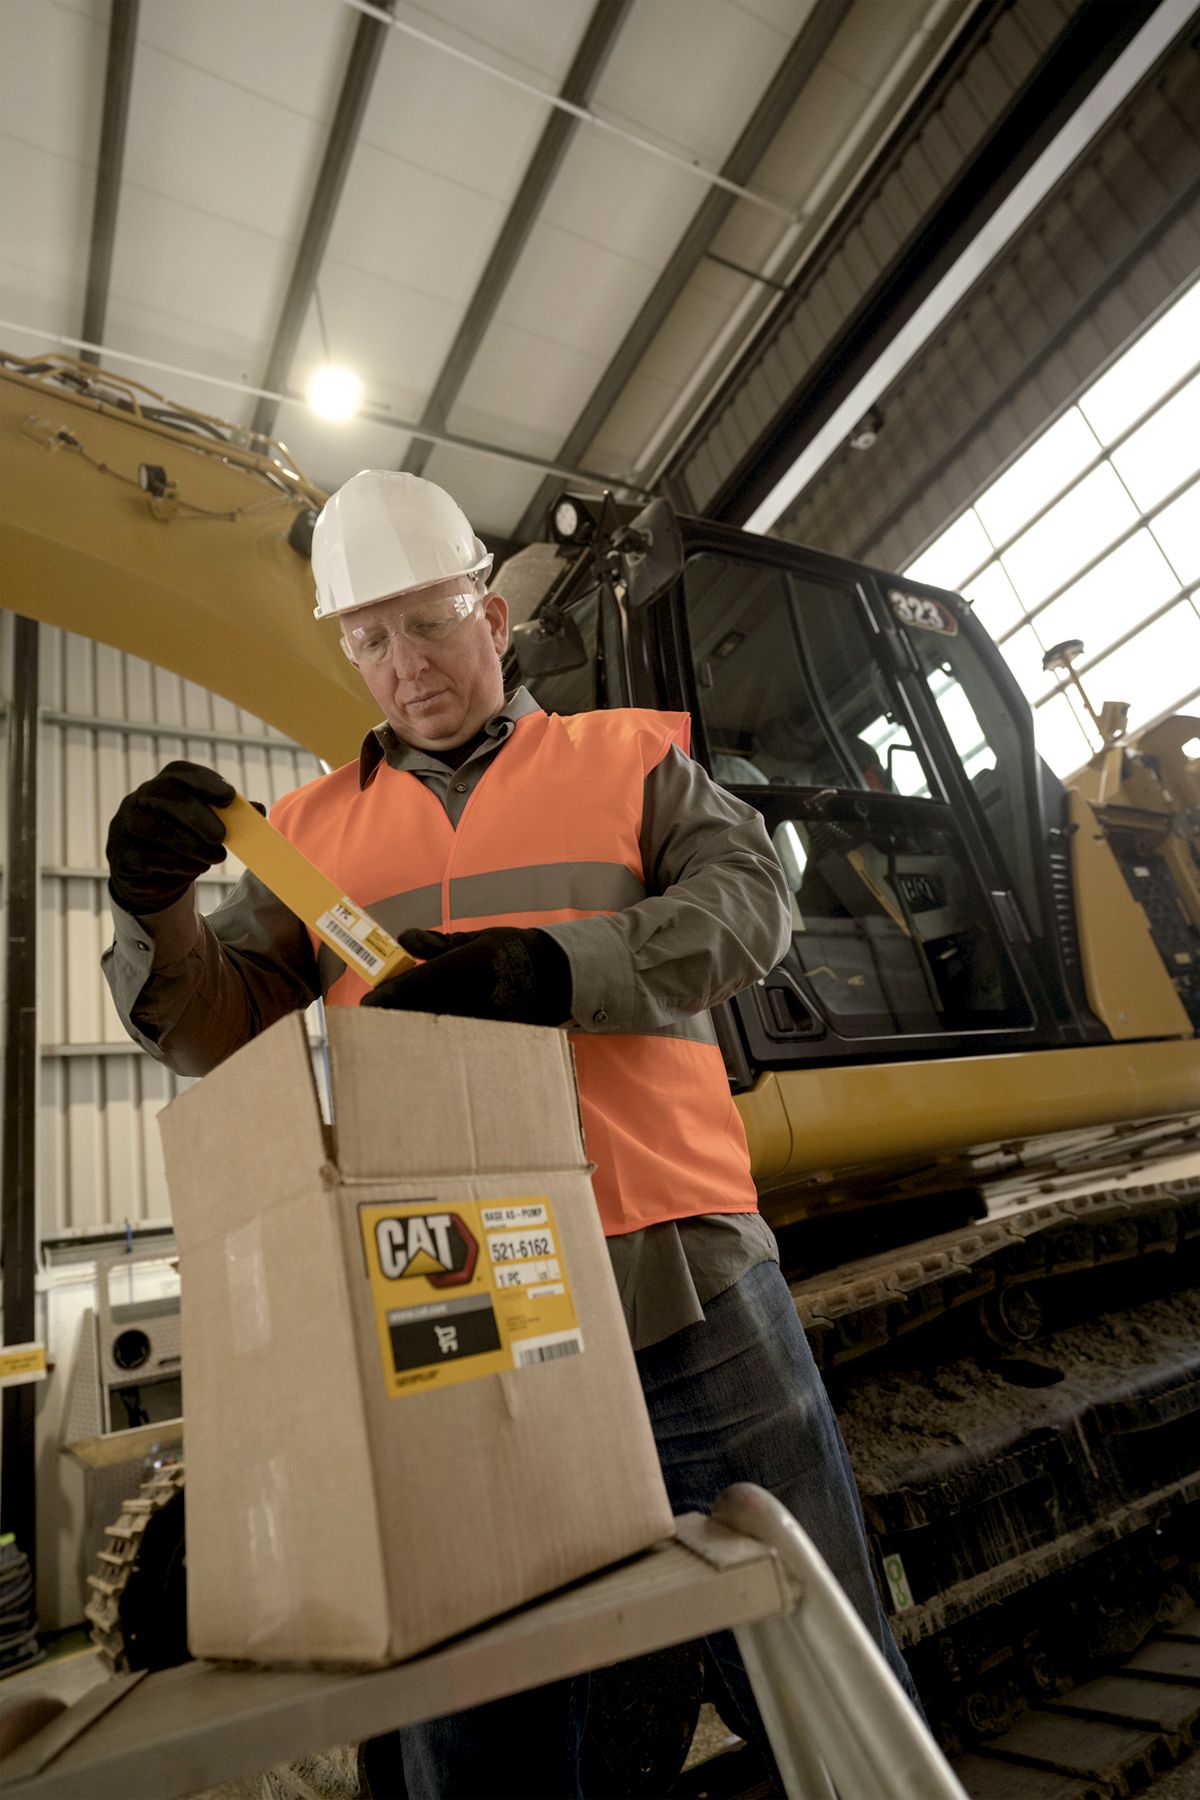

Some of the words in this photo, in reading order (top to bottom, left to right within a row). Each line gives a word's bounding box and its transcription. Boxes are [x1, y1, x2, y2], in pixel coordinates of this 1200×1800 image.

[890, 591, 945, 629] 323
[375, 1213, 454, 1281] CAT
[491, 1237, 550, 1262] 521-6162
[498, 1273, 506, 1287] 1
[507, 1271, 521, 1286] PC
